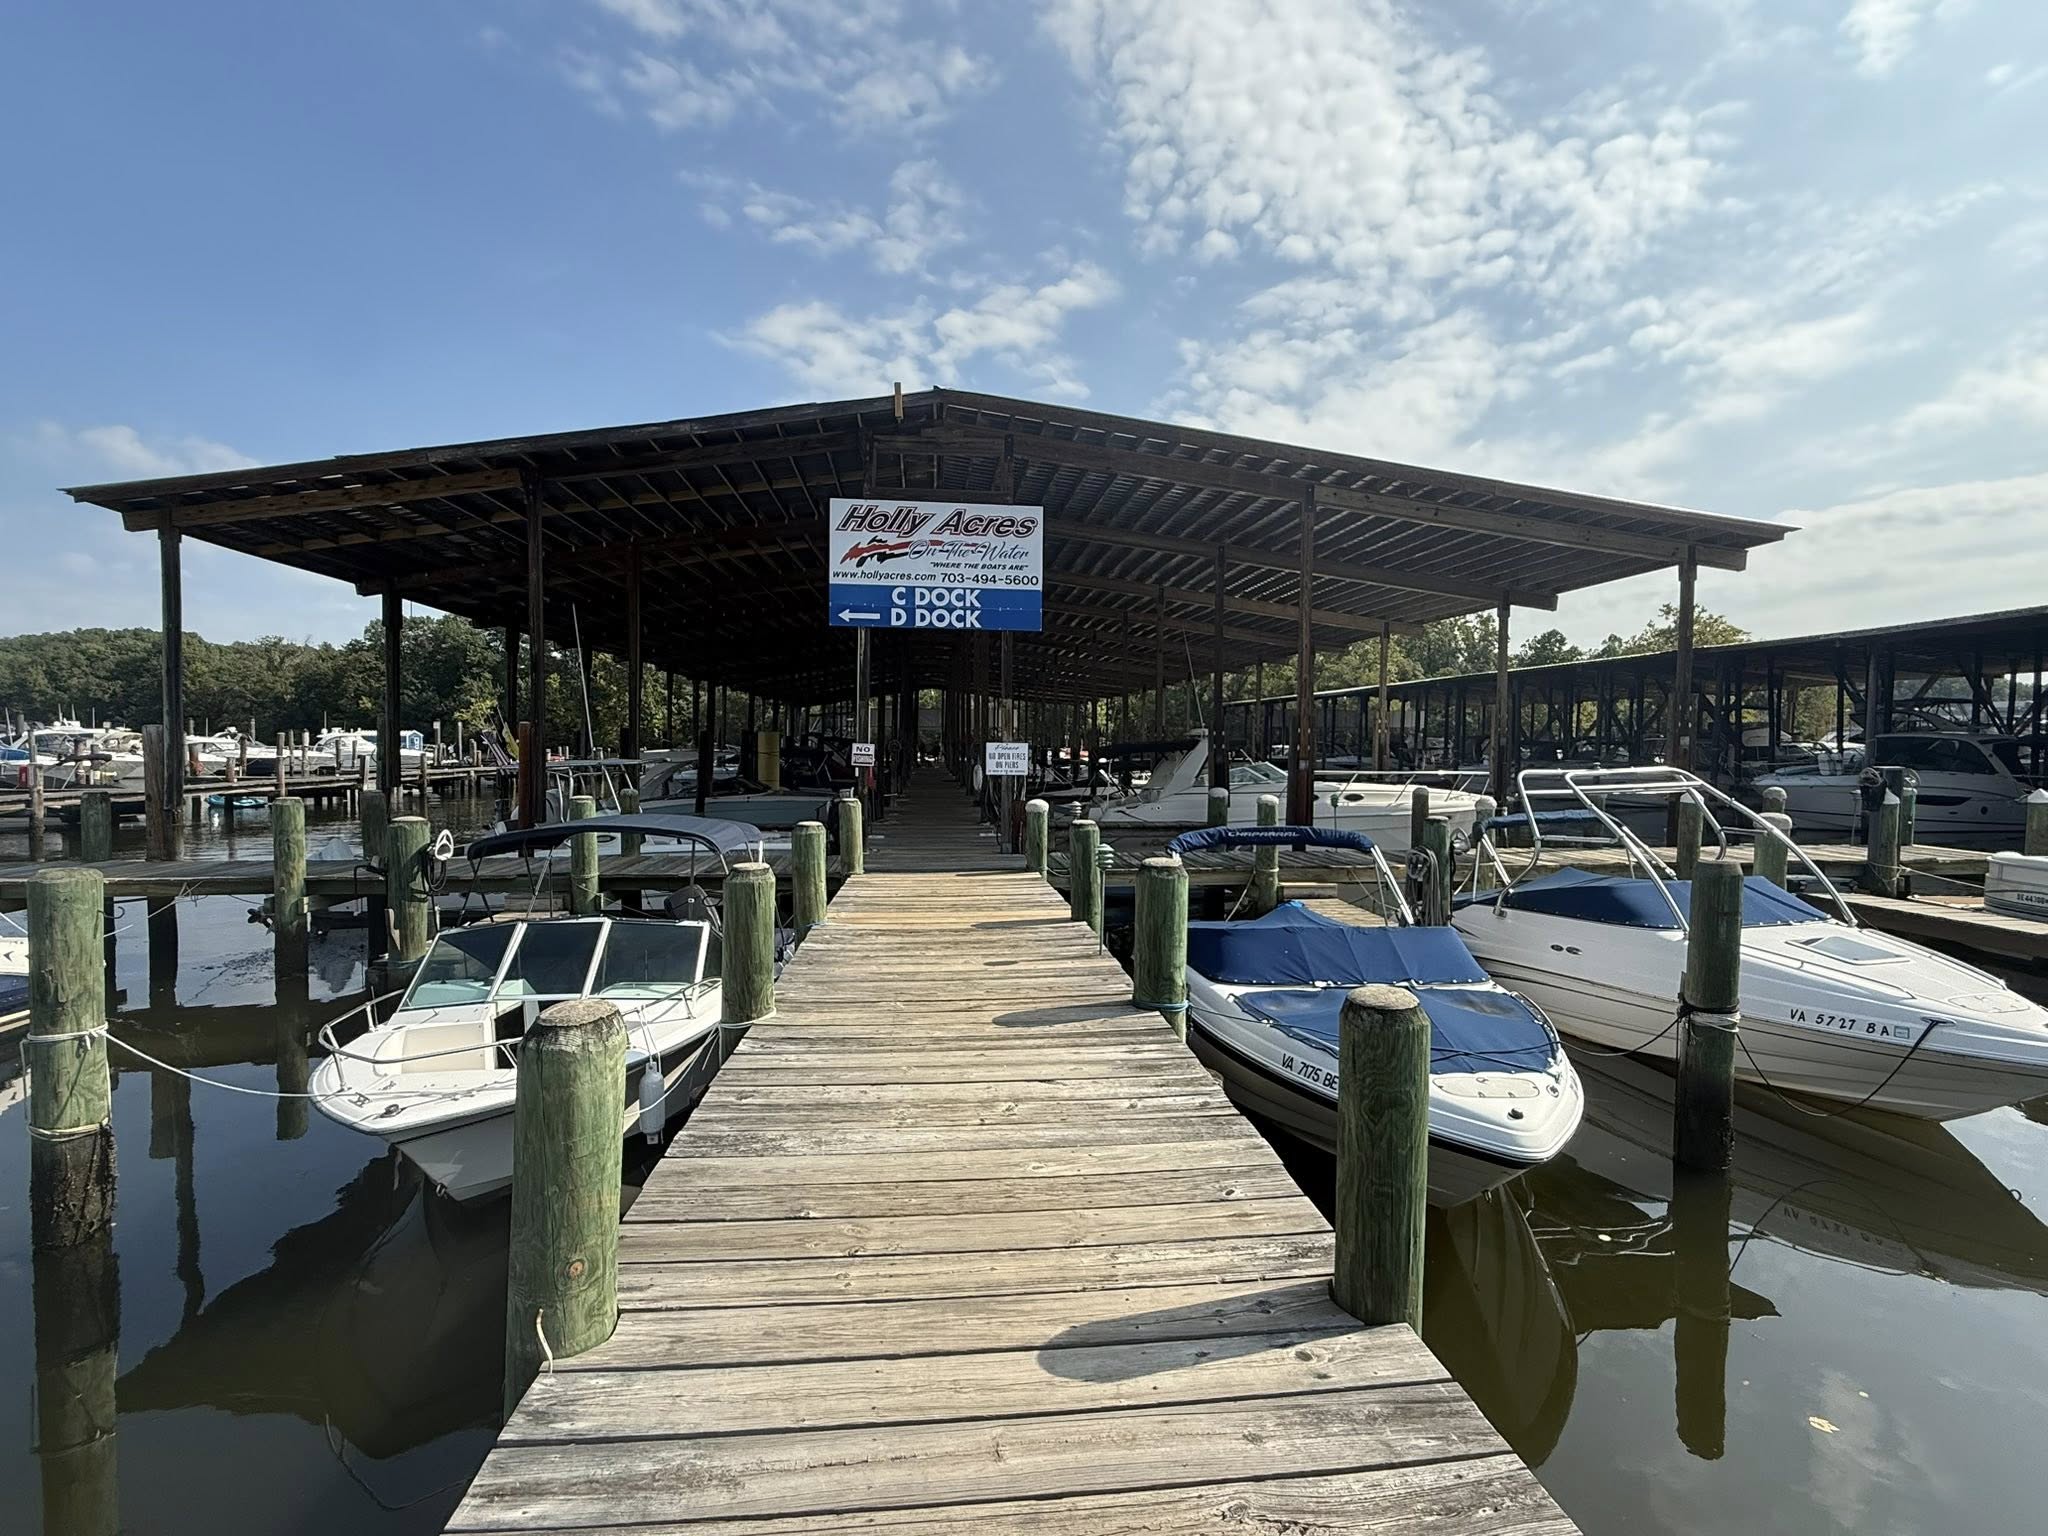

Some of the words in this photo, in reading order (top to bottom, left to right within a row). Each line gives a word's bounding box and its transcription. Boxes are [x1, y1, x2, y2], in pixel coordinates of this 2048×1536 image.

[835, 503, 936, 538] Holly
[931, 508, 1039, 538] Acres
[930, 561, 961, 569] "WHERE
[964, 562, 980, 570] THE
[980, 563, 1007, 571] BOATS
[832, 569, 937, 582] www.hollyacres.com
[940, 572, 1039, 586] 703-494-5600
[891, 586, 906, 606] C
[914, 587, 982, 608] DOCK
[890, 607, 907, 626] D
[915, 608, 982, 628] DOCK
[997, 752, 1011, 761] OPEN
[1012, 752, 1026, 761] FIRES
[1790, 1008, 1806, 1022] VA
[1815, 1013, 1857, 1031] 5727
[1281, 1052, 1295, 1072] VA
[1297, 1061, 1323, 1083] 7175
